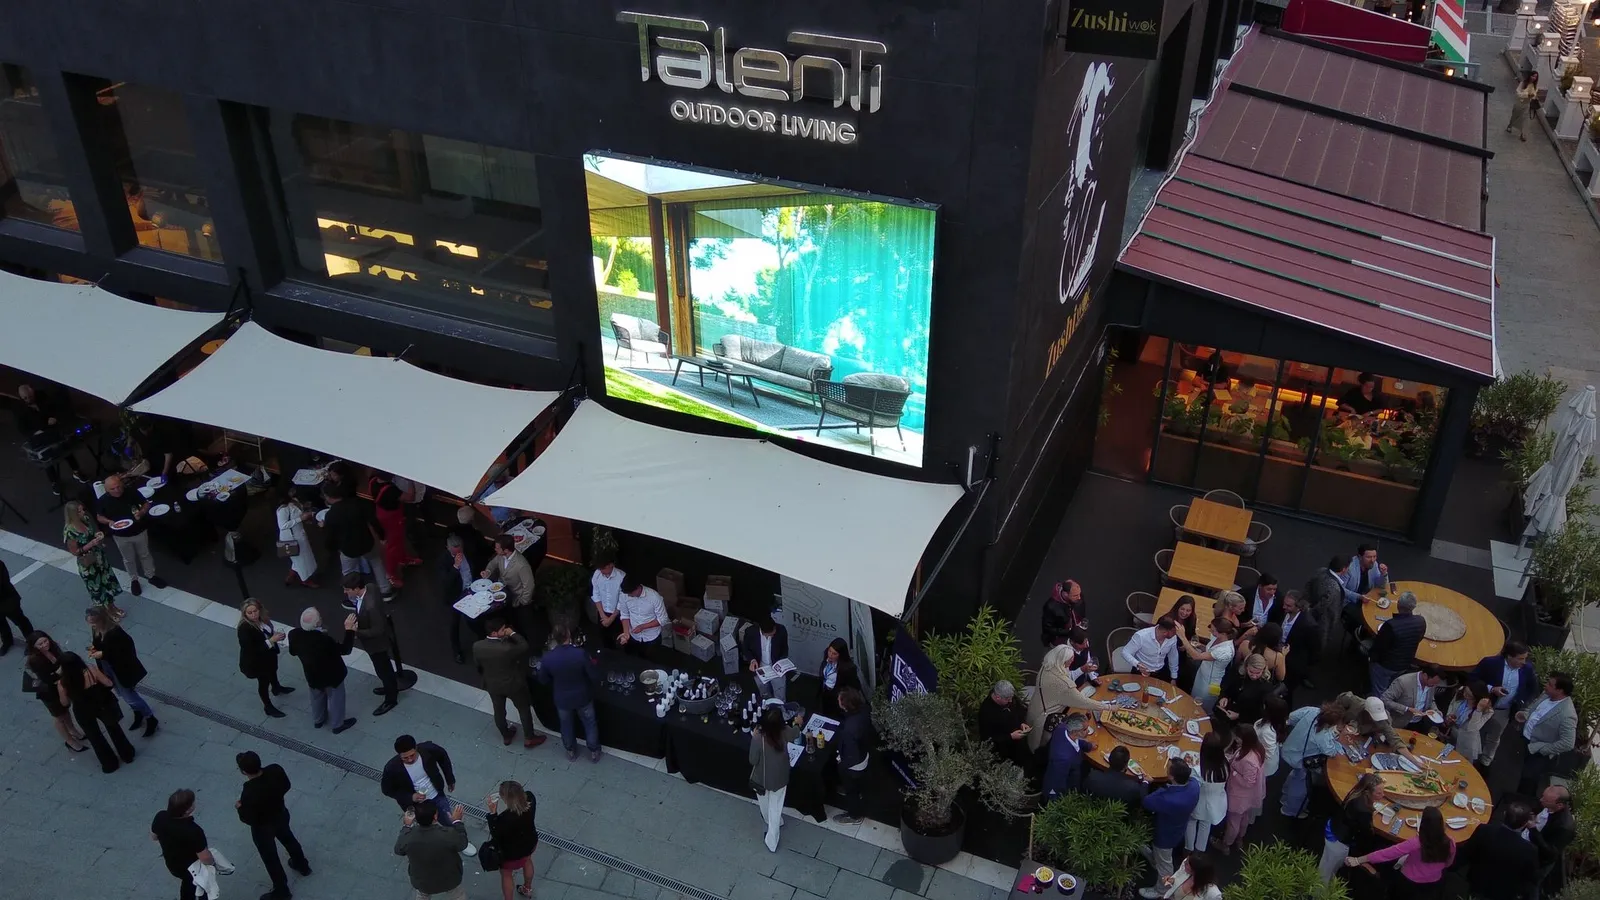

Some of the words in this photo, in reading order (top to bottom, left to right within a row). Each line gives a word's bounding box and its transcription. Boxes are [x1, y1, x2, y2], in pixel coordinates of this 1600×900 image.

[1071, 8, 1128, 32] Zushi
[1128, 19, 1157, 32] wok
[670, 100, 776, 133] OUTDOOR
[781, 114, 857, 144] LIVING
[793, 612, 837, 632] Robles
